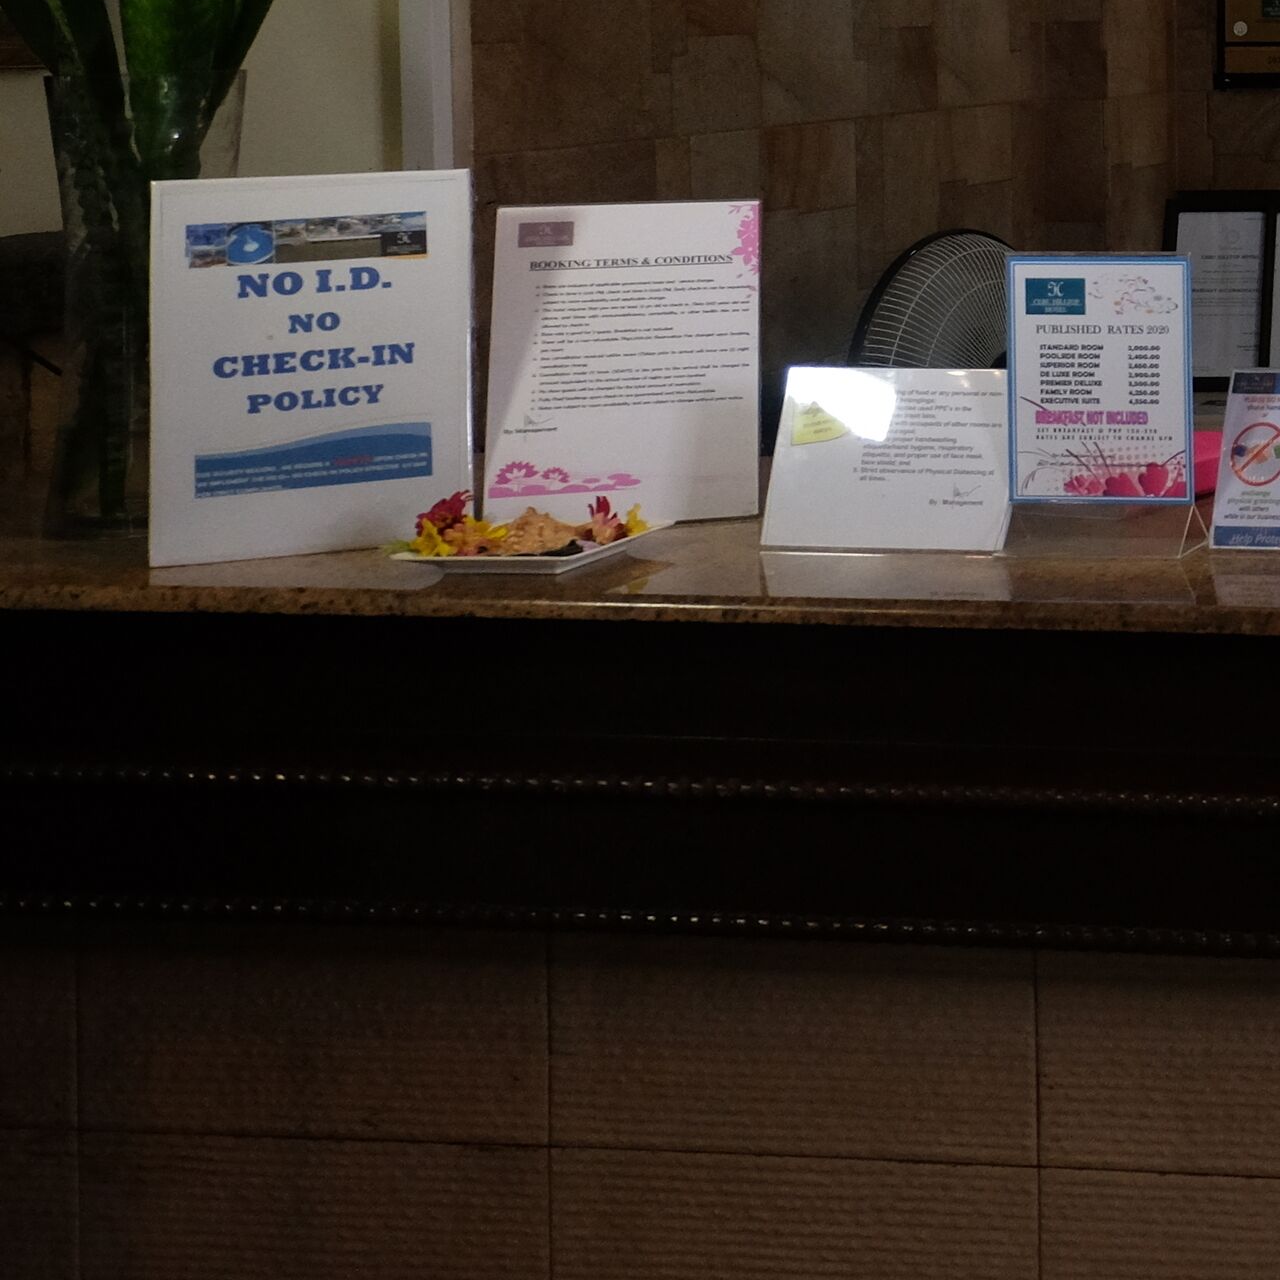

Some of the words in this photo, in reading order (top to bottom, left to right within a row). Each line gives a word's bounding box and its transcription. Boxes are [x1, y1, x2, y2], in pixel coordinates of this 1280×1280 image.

[530, 258, 591, 270] BOOKING
[594, 257, 639, 268] TERMS
[641, 256, 651, 266] &
[654, 254, 733, 266] CONDITIONS
[237, 271, 303, 298] NO
[315, 267, 391, 293] I.D.
[288, 312, 340, 334] NO
[1036, 324, 1101, 335] PUBLISHED
[1107, 324, 1145, 335] RATES
[1146, 324, 1170, 335] 2020
[1040, 343, 1079, 351] STANDARD
[1081, 343, 1104, 351] ROOM
[212, 342, 415, 379] CHECK-IN
[1040, 352, 1076, 360] POOLSIDE
[1078, 352, 1100, 360] ROOM
[1040, 361, 1075, 369] SUPERIOR
[1077, 361, 1100, 369] ROOM
[1052, 370, 1070, 378] LUXE
[1072, 370, 1095, 378] ROOM
[1040, 379, 1072, 387] PREMIER
[1074, 379, 1102, 387] DELUXE
[1040, 388, 1068, 396] FAMILY
[1069, 388, 1092, 396] ROOM
[247, 384, 384, 414] POLICY
[1041, 397, 1079, 405] EXECUTIVE
[1082, 397, 1101, 405] SUITE
[1087, 411, 1104, 424] NOT
[1106, 411, 1149, 425] INCLUDED
[942, 497, 984, 508] Management
[1232, 533, 1253, 546] Help
